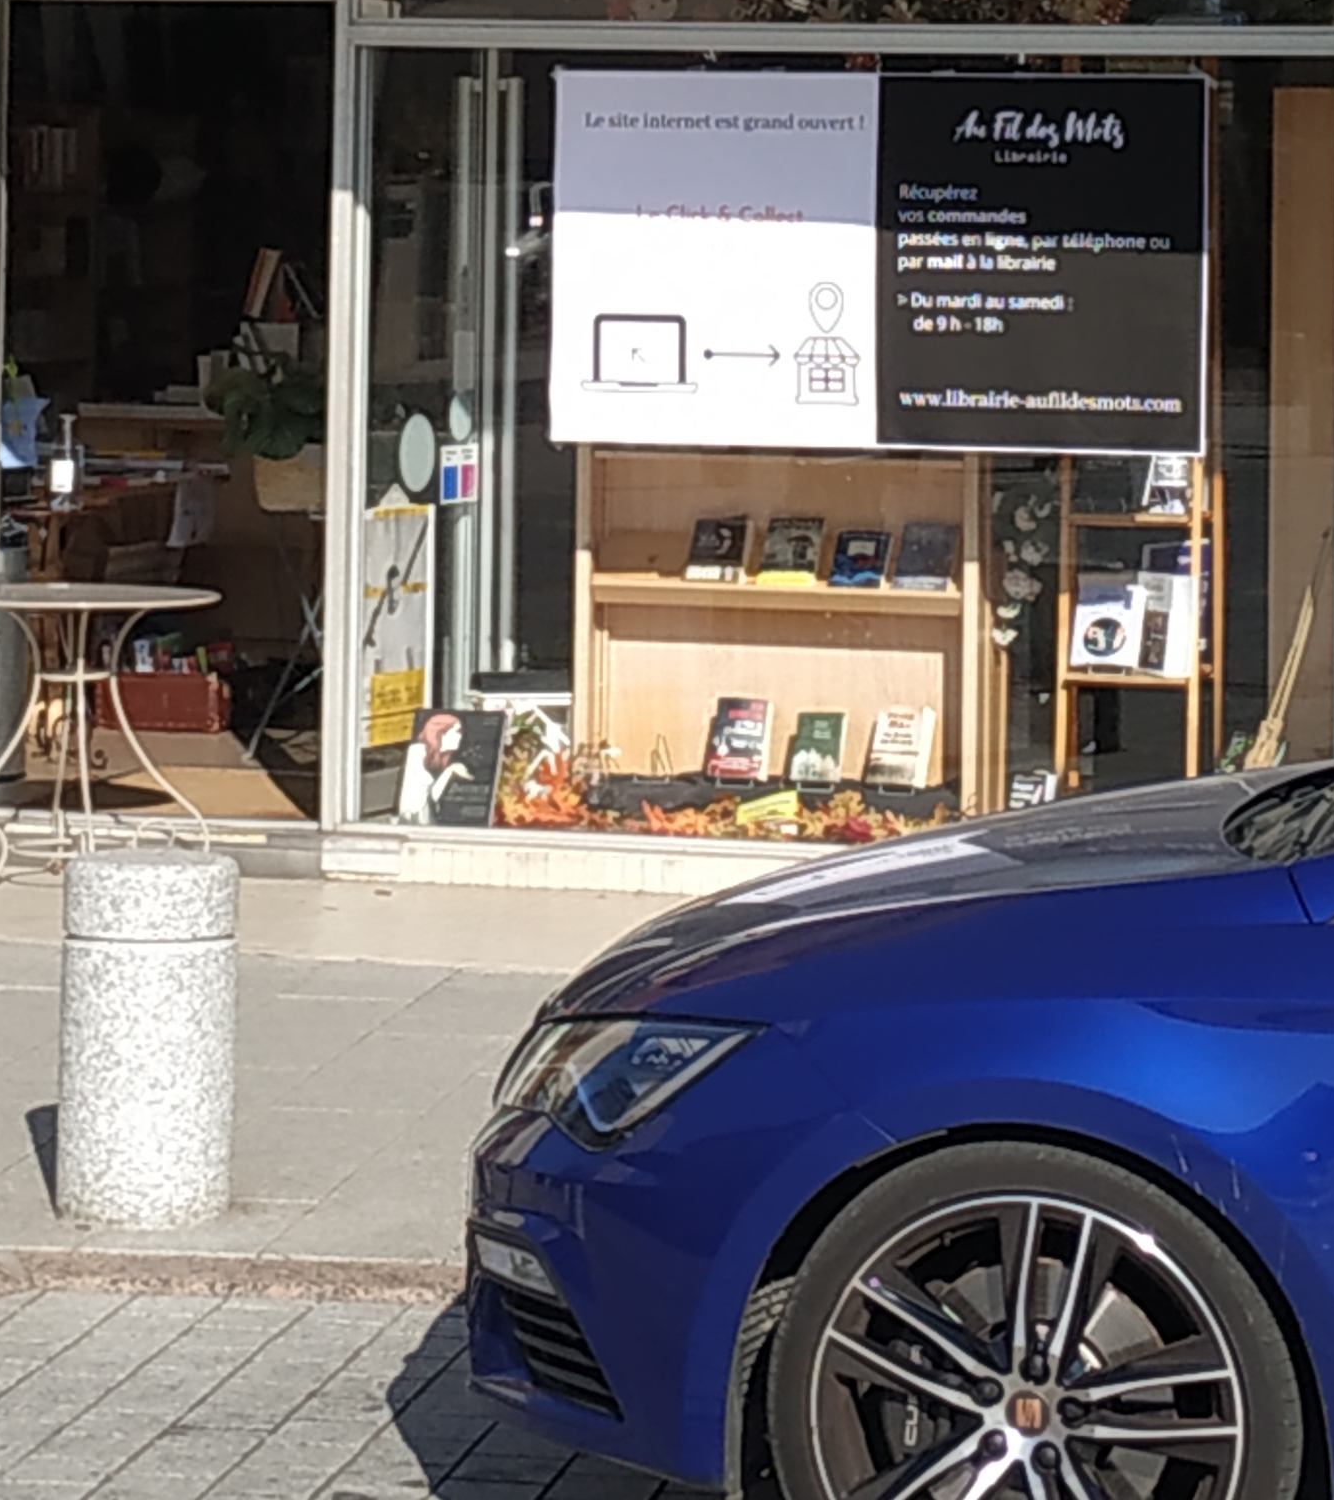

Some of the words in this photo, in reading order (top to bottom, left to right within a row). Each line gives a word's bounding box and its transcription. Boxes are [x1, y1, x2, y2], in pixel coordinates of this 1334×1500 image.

[585, 112, 606, 129] Le
[608, 112, 640, 130] site
[643, 112, 711, 130] internet
[714, 114, 740, 130] est
[743, 112, 794, 134] grand
[798, 114, 855, 132] ouvert
[899, 184, 979, 204] Récupérez
[898, 210, 925, 223] vos
[927, 208, 1027, 224] commandes
[898, 232, 958, 250] passées
[962, 236, 982, 248] en
[1031, 236, 1058, 252] par
[1062, 233, 1146, 253] téléphone
[1149, 237, 1170, 250] ou
[898, 257, 924, 272] par
[927, 254, 964, 270] mail
[966, 254, 976, 270] à
[979, 255, 994, 270] la
[997, 255, 1057, 272] librairie
[910, 293, 934, 308] Du
[936, 293, 982, 309] mardi
[985, 297, 1005, 309] au
[1008, 294, 1065, 311] samedi
[913, 316, 934, 332] de
[899, 388, 1182, 413] www.librairie-aufildesmots.com
